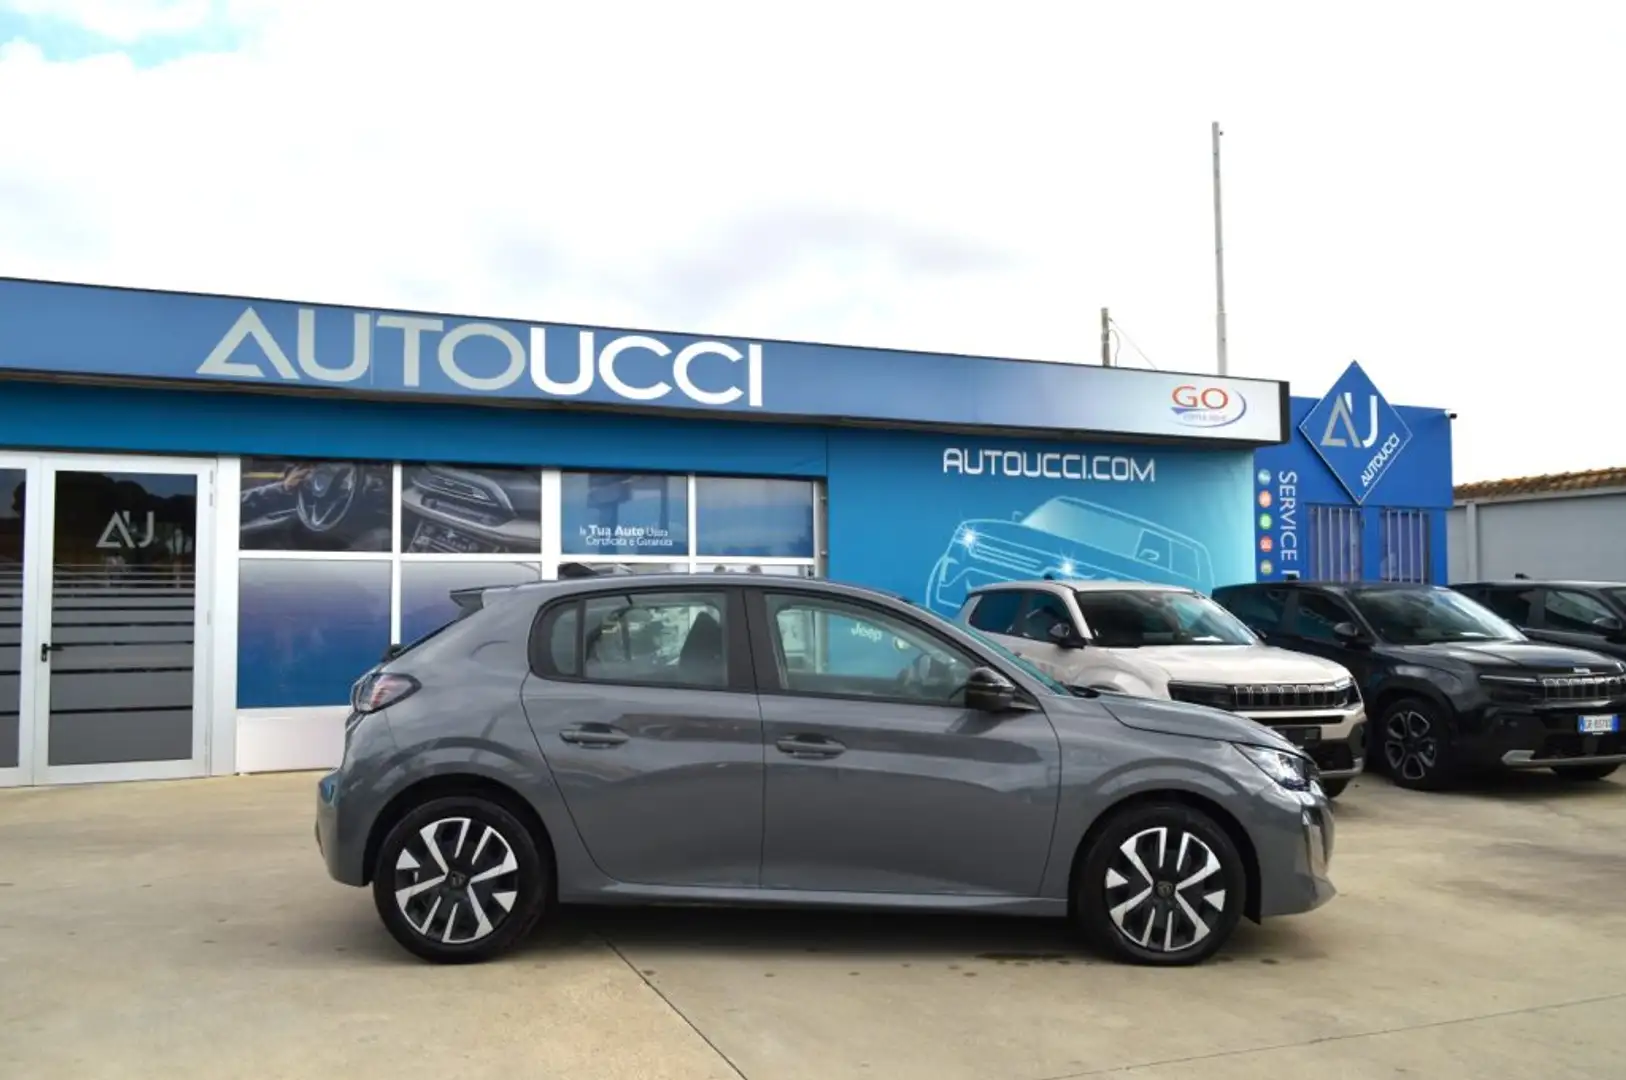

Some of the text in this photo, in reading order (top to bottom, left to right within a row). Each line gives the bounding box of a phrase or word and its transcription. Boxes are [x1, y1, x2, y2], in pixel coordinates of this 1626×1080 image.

[196, 306, 763, 407] AUTOUCCI
[1172, 385, 1229, 410] GO
[942, 447, 1156, 483] AUTOUCCI.COM
[588, 524, 611, 536] Tua
[614, 525, 645, 536] Auto
[1279, 471, 1298, 561] SERVICE
[851, 621, 883, 643] Jeep
